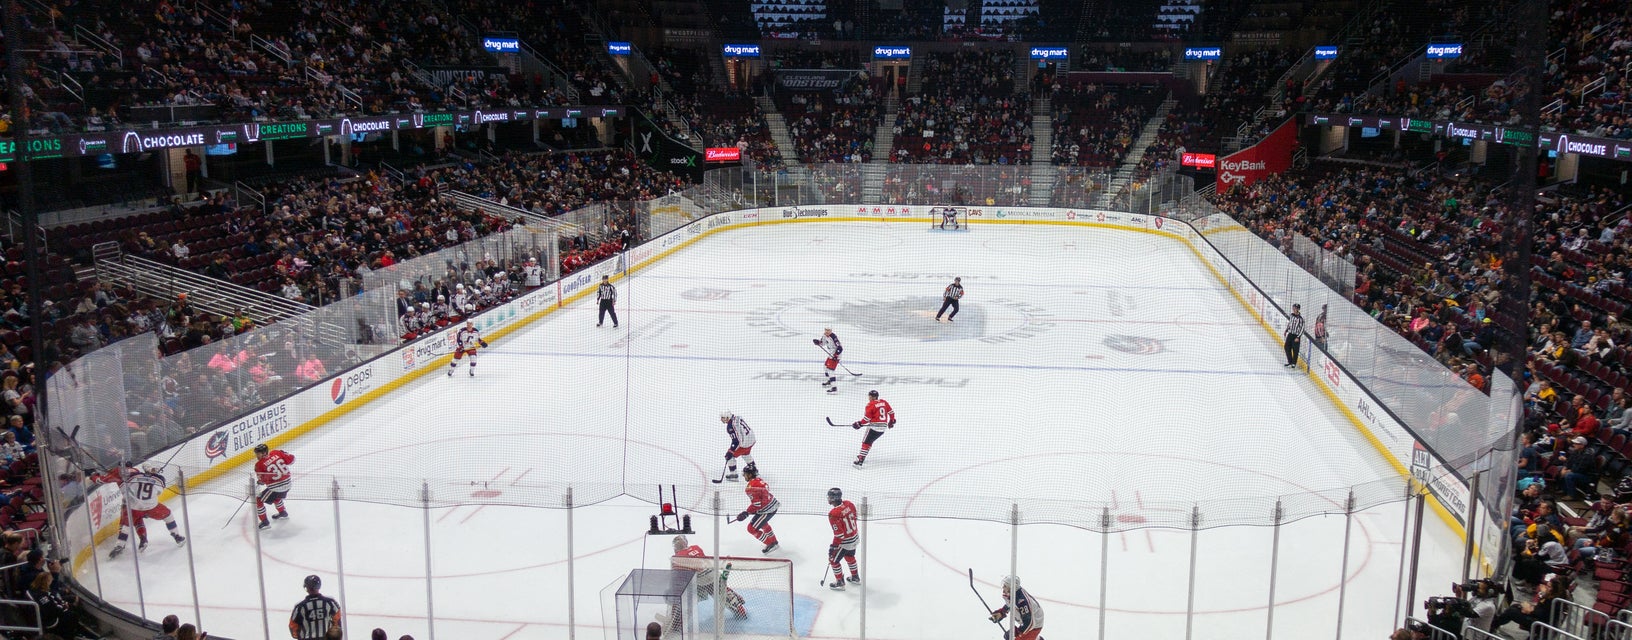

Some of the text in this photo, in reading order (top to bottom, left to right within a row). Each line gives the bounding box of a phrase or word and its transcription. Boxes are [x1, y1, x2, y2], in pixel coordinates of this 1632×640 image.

[484, 40, 519, 50] drug mart
[724, 46, 741, 54] drug
[1427, 45, 1462, 56] drug mart
[875, 47, 892, 56] drug
[1032, 48, 1049, 57] drug
[1186, 48, 1202, 58] drug
[424, 114, 453, 122] CREATIONS
[482, 112, 508, 122] CHOCOLATE
[261, 123, 307, 134] CREATIONS
[353, 121, 390, 132] CHOCOLATE
[1454, 129, 1477, 138] CHOCOLATE
[0, 138, 61, 151] EAIONS
[144, 134, 204, 148] CHOCOLATE
[707, 150, 738, 158] Budweiser
[1569, 141, 1606, 156] CHOCOLATE
[1183, 155, 1214, 164] Budweiser
[1221, 160, 1266, 171] KeyBank
[783, 208, 828, 217] Blue Technologies
[563, 274, 591, 294] GOODYEAR
[416, 344, 431, 358] drug
[432, 338, 446, 351] mart
[347, 364, 372, 391] pepsi
[232, 404, 286, 434] COLUMBUS
[880, 407, 886, 420] 9
[234, 415, 287, 451] BLUE JACKETS
[267, 458, 290, 480] 36
[137, 482, 154, 500] 19
[843, 513, 857, 534] 16
[1020, 605, 1029, 615] 28
